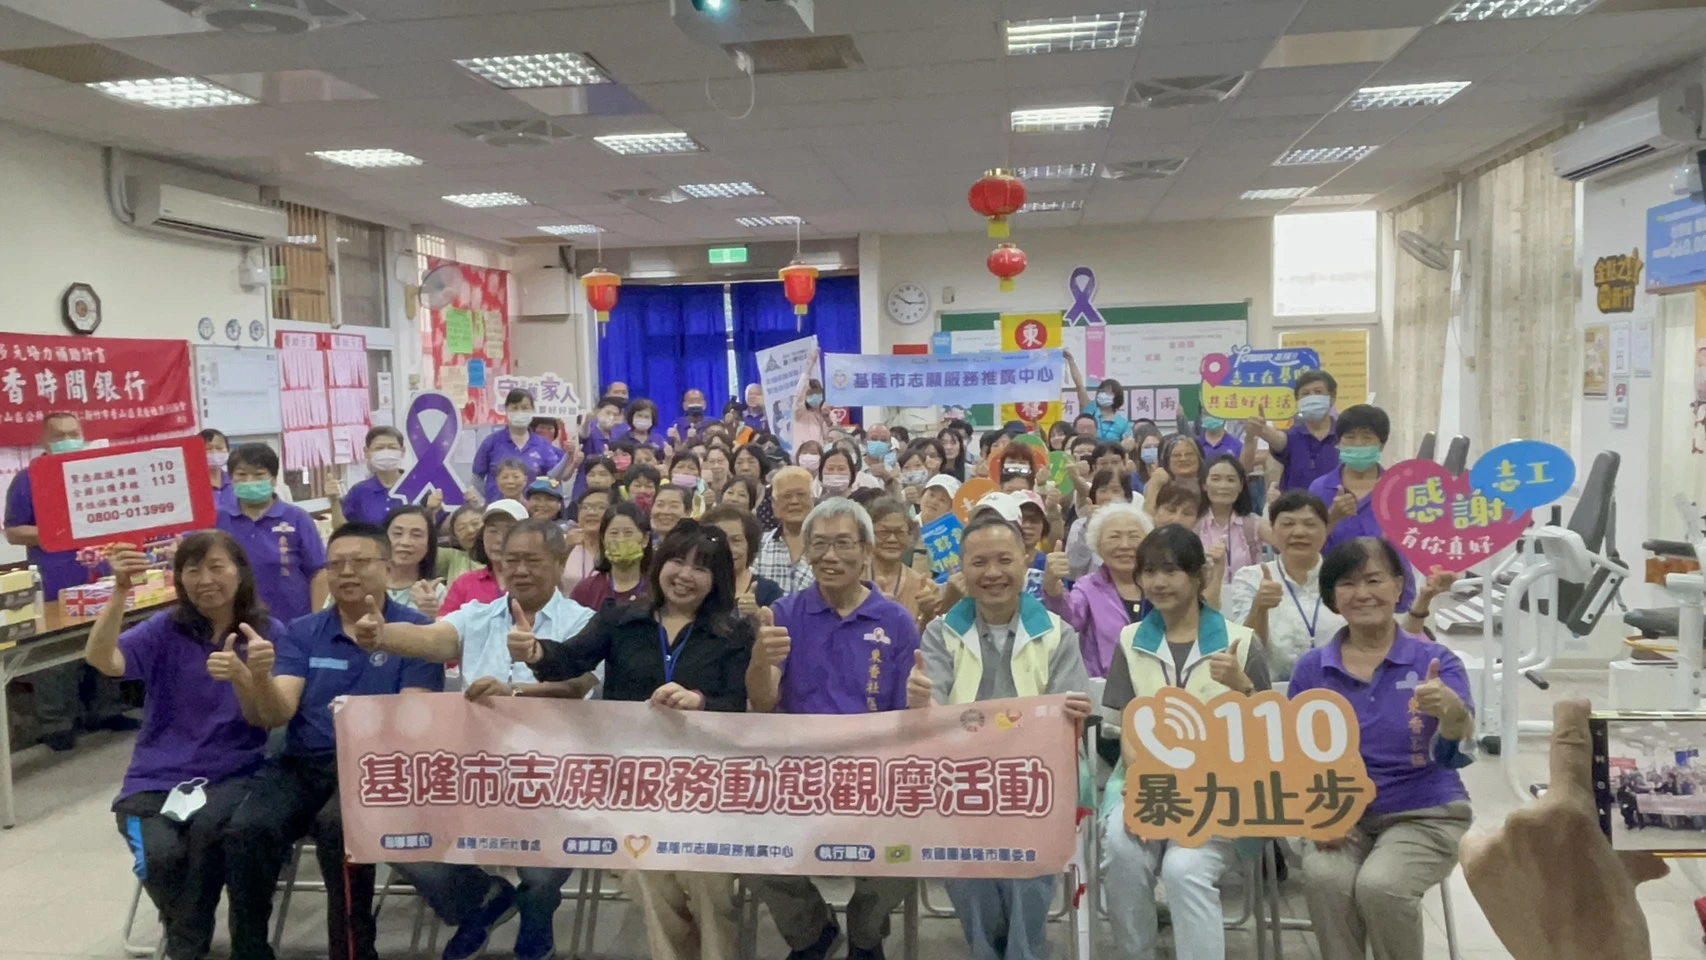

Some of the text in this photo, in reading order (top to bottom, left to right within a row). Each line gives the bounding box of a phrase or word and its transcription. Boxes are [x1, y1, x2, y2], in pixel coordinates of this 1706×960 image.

[1021, 322, 1043, 348] 東
[2, 367, 146, 405] 香時間銀行
[853, 366, 1054, 389] 基隆市志願服務推廣中心
[1208, 393, 1291, 409] 共造好生活
[149, 460, 174, 473] 110
[152, 474, 176, 486] 113
[1492, 459, 1554, 492] 志工
[87, 502, 175, 523] 0800-013999
[1405, 477, 1505, 530] 感謝
[1402, 527, 1494, 560] 有你真好
[1214, 700, 1348, 763] 110
[360, 752, 1053, 815] 基隆市志願服務動態觀摩活動
[1133, 768, 1364, 837] 暴力止步
[457, 837, 541, 852] 基隆市政府社會處
[566, 839, 613, 853] 承辦單位
[656, 841, 794, 858] 基隆市志願服務推廣中心
[819, 846, 871, 861] 執行單位
[921, 847, 1037, 862] 救國團基隆市團委會
